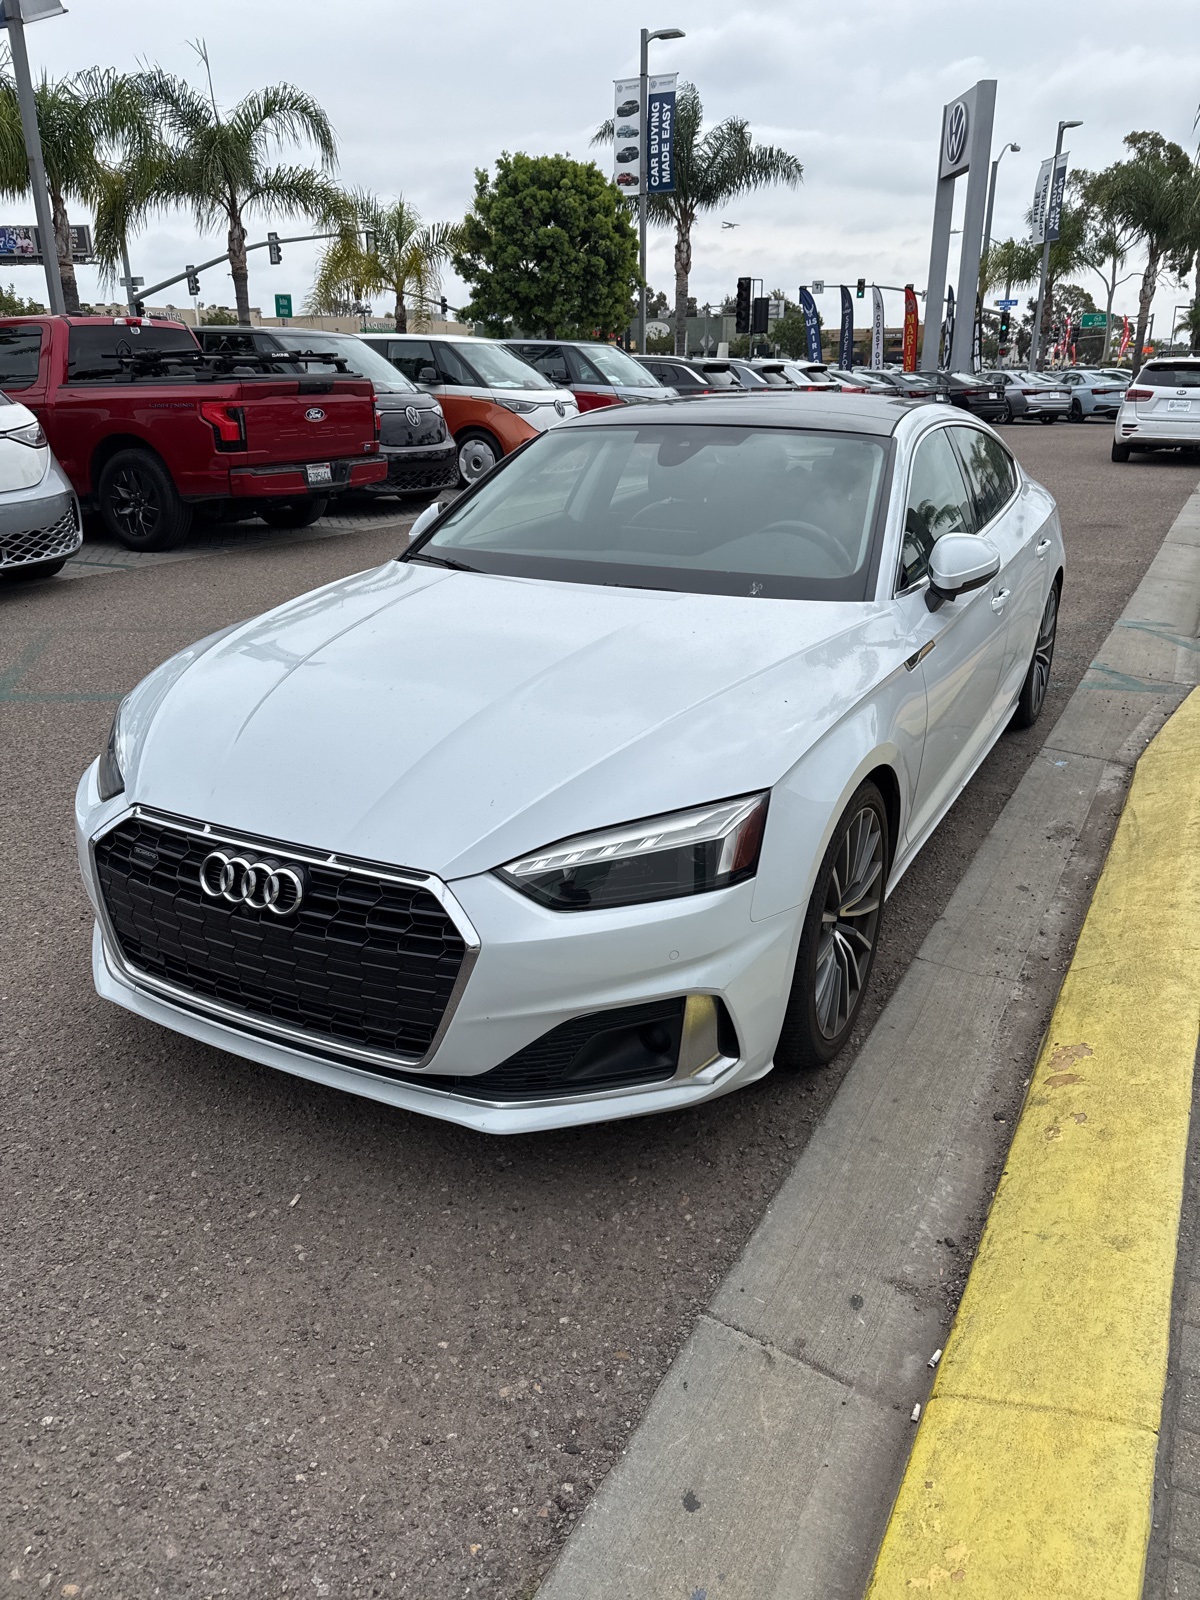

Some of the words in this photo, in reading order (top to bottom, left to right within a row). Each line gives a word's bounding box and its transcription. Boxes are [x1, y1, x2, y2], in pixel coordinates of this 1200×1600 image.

[650, 101, 660, 154] BUYING
[661, 103, 672, 140] EASY
[650, 158, 659, 186] CAR
[661, 142, 671, 183] MADE
[1033, 190, 1041, 223] FREE
[1038, 174, 1050, 237] APPRAISALS
[1057, 176, 1065, 203] CAR
[1048, 209, 1056, 230] WE
[810, 328, 818, 350] AIR
[942, 316, 953, 370] NAV
